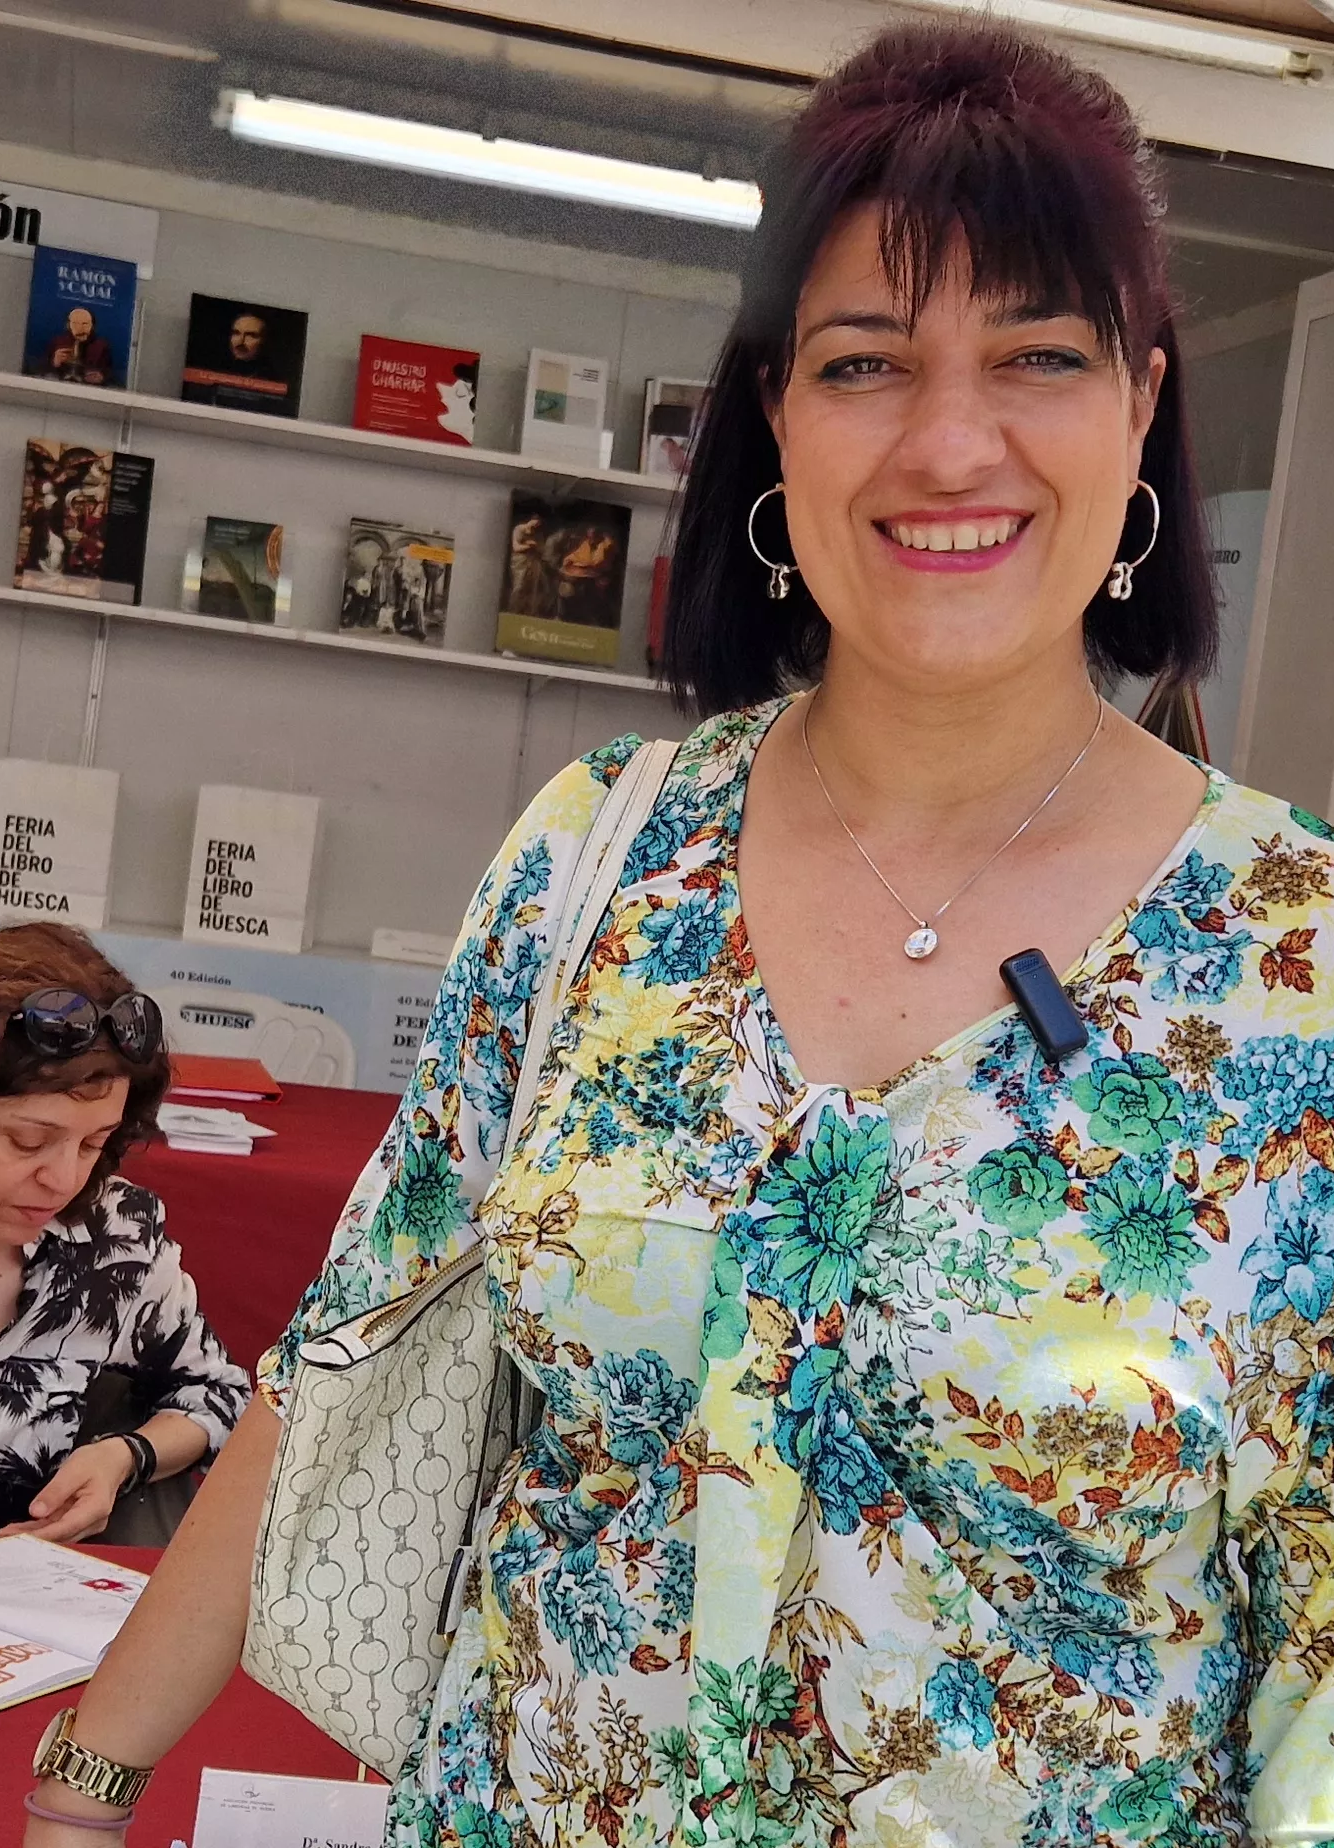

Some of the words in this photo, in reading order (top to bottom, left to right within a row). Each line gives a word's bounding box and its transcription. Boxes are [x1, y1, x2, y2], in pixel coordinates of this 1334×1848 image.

[1211, 549, 1241, 565] BRO
[5, 814, 56, 838] FERIA
[2, 833, 35, 854] DEL
[207, 839, 256, 862] FERIA
[0, 851, 53, 874] LIBRO
[205, 858, 236, 878] DEL
[202, 875, 253, 899] LIBRO
[201, 894, 223, 912] DE
[198, 911, 269, 937] HUESCA
[169, 969, 185, 981] 40
[187, 971, 232, 986] Edición
[397, 996, 412, 1007] 40
[193, 1013, 256, 1030] HUESC
[394, 1014, 430, 1030] FER
[392, 1034, 418, 1049] DE
